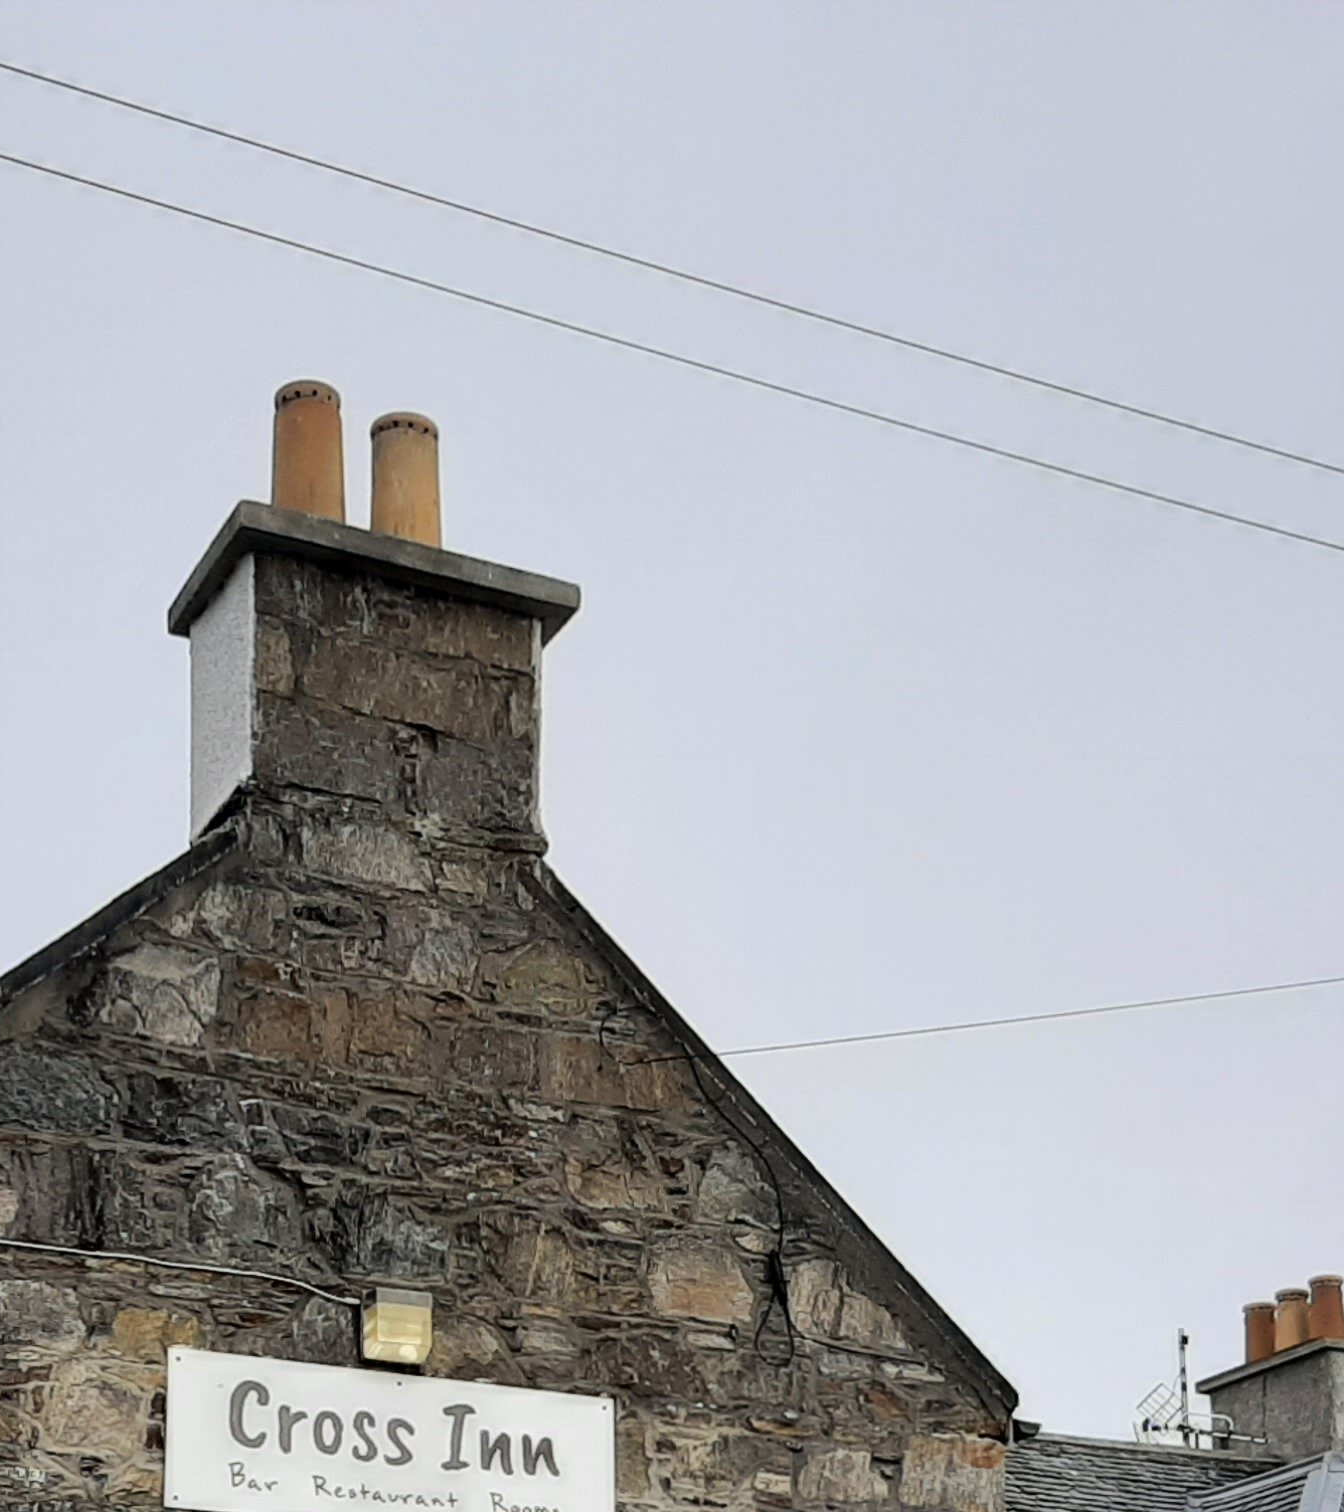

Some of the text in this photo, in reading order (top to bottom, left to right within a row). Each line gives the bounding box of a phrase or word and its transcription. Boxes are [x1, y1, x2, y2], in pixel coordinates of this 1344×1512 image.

[229, 1380, 560, 1477] Cross Inn
[229, 1462, 278, 1492] Bar
[313, 1475, 459, 1508] Restaurant
